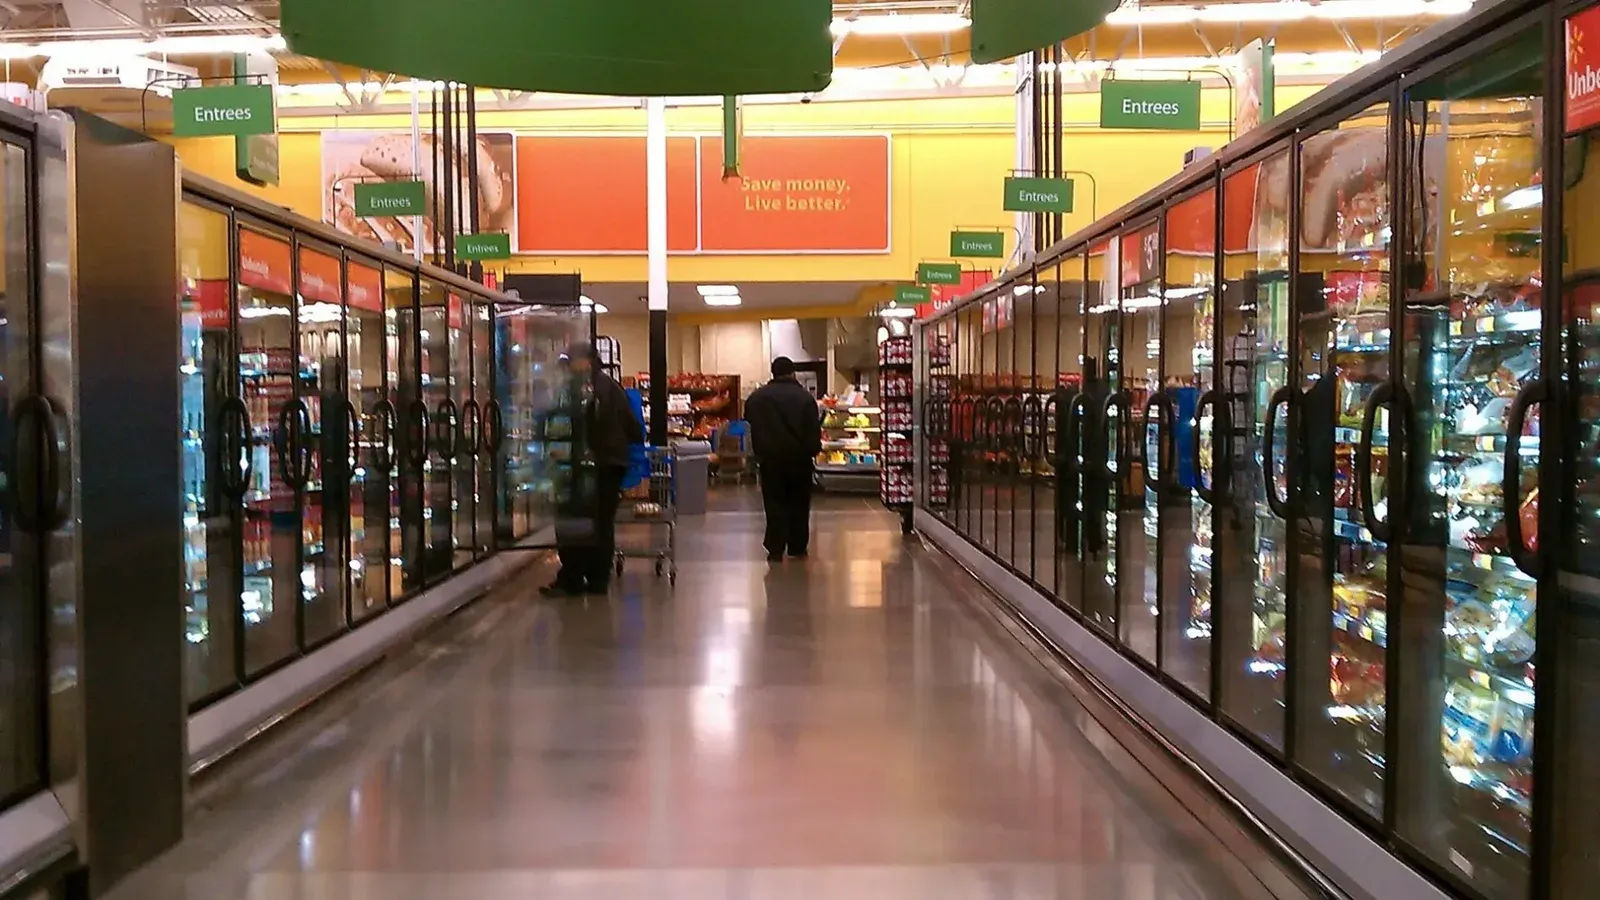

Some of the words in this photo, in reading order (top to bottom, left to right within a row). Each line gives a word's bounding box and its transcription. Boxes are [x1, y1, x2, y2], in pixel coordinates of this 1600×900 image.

[1122, 98, 1179, 115] Entrees
[194, 106, 252, 122] Entrees
[742, 176, 782, 192] Save
[785, 178, 851, 195] money.
[370, 196, 412, 208] Entrees
[744, 194, 782, 211] Live
[785, 194, 846, 211] better.
[1019, 190, 1060, 204] Entrees
[466, 243, 499, 254] Entrees
[961, 240, 993, 251] Entrees
[926, 270, 953, 280] Entrees
